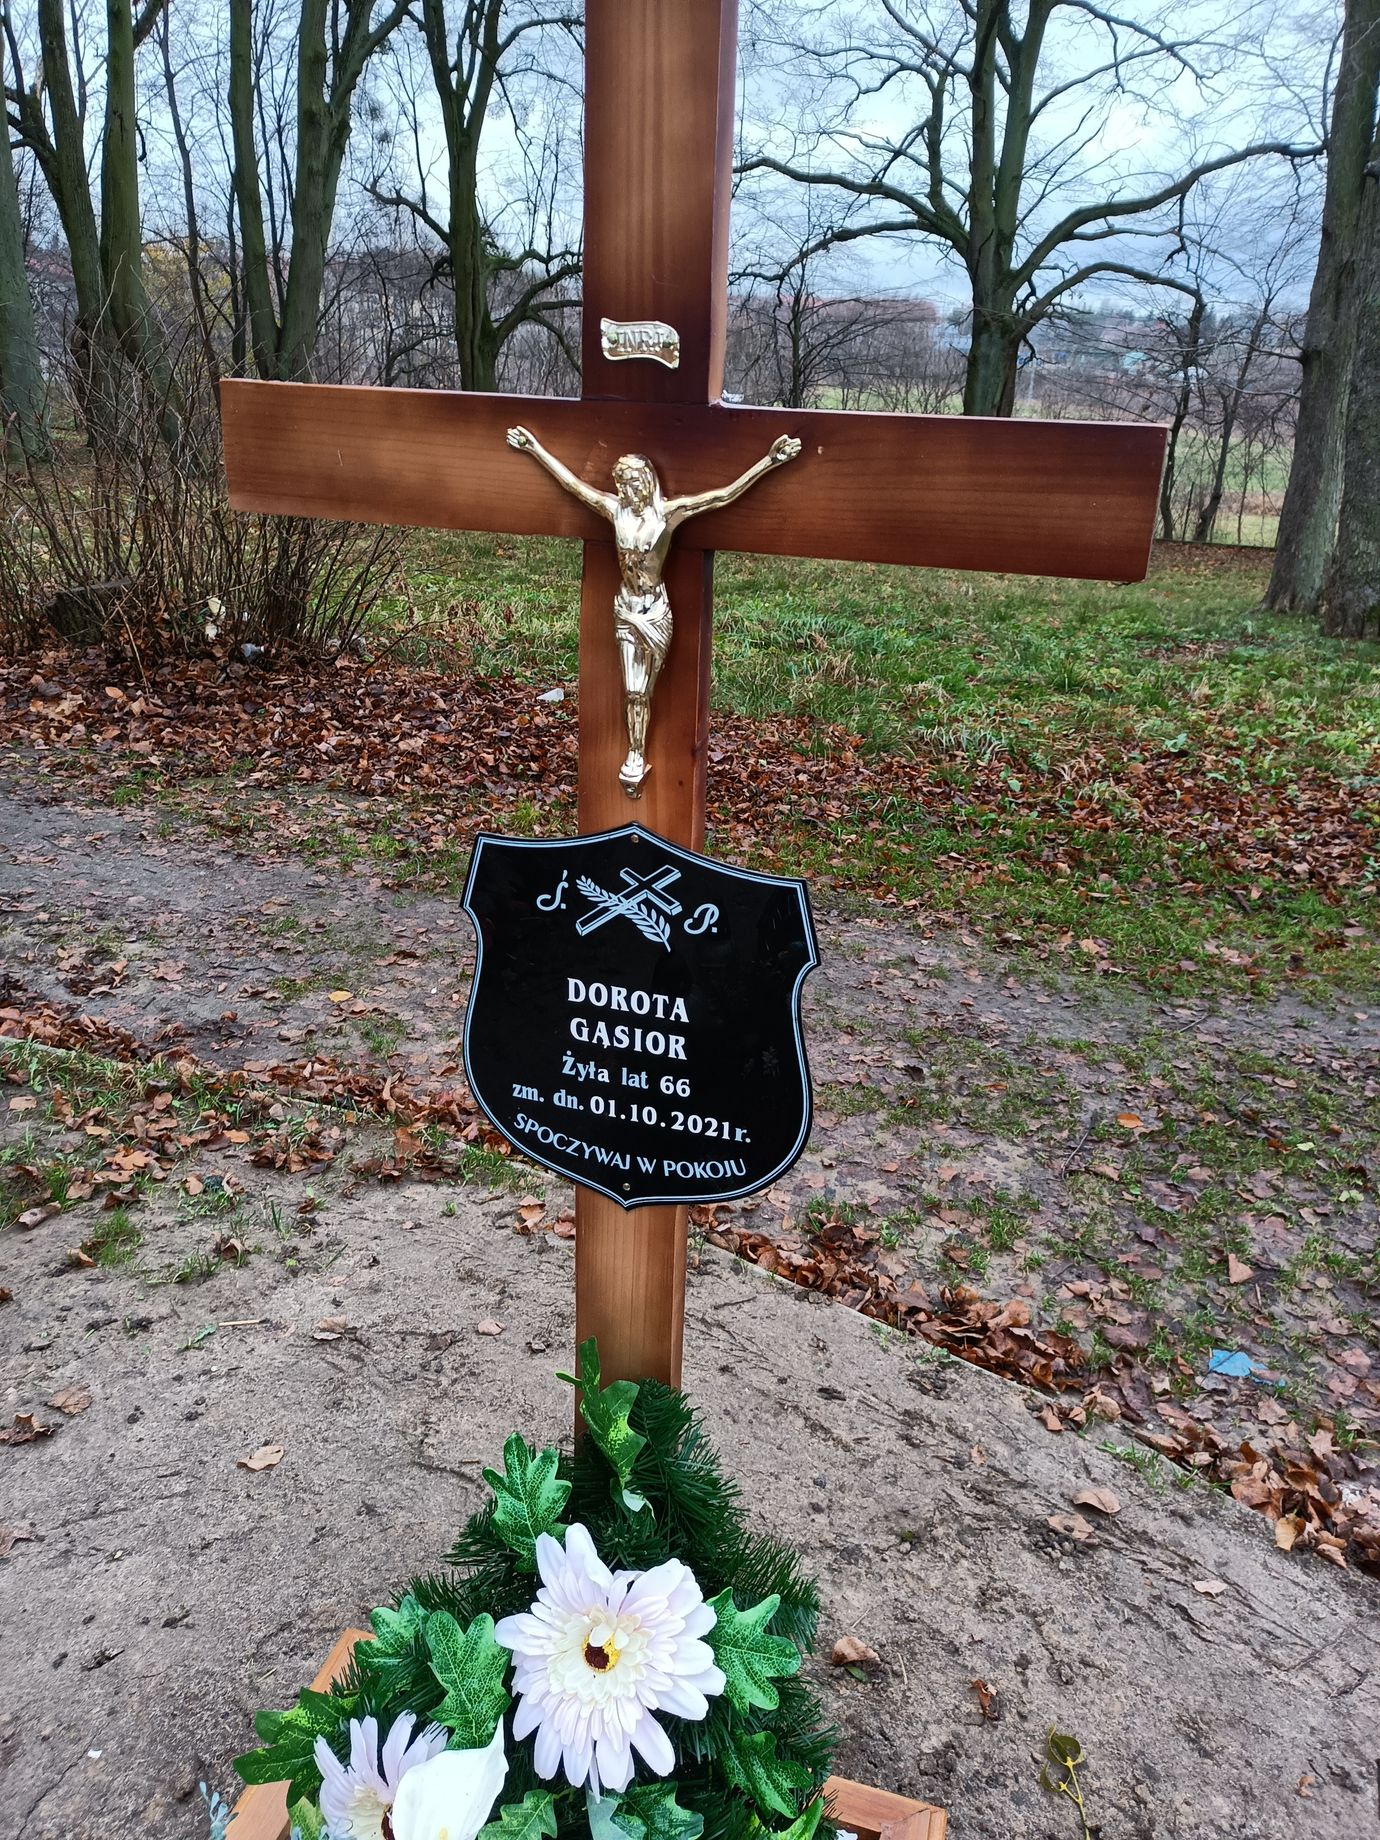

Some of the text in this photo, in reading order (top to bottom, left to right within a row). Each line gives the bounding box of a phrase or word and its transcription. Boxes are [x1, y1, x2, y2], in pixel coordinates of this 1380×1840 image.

[567, 977, 690, 1023] DOROTA
[569, 1017, 688, 1061] GĄSIOR
[512, 1083, 546, 1103] zm.
[553, 1088, 586, 1111] dn.
[561, 1050, 692, 1098] Żyła lat 66
[513, 1112, 747, 1179] SPOCZYWAJ W POKOJU
